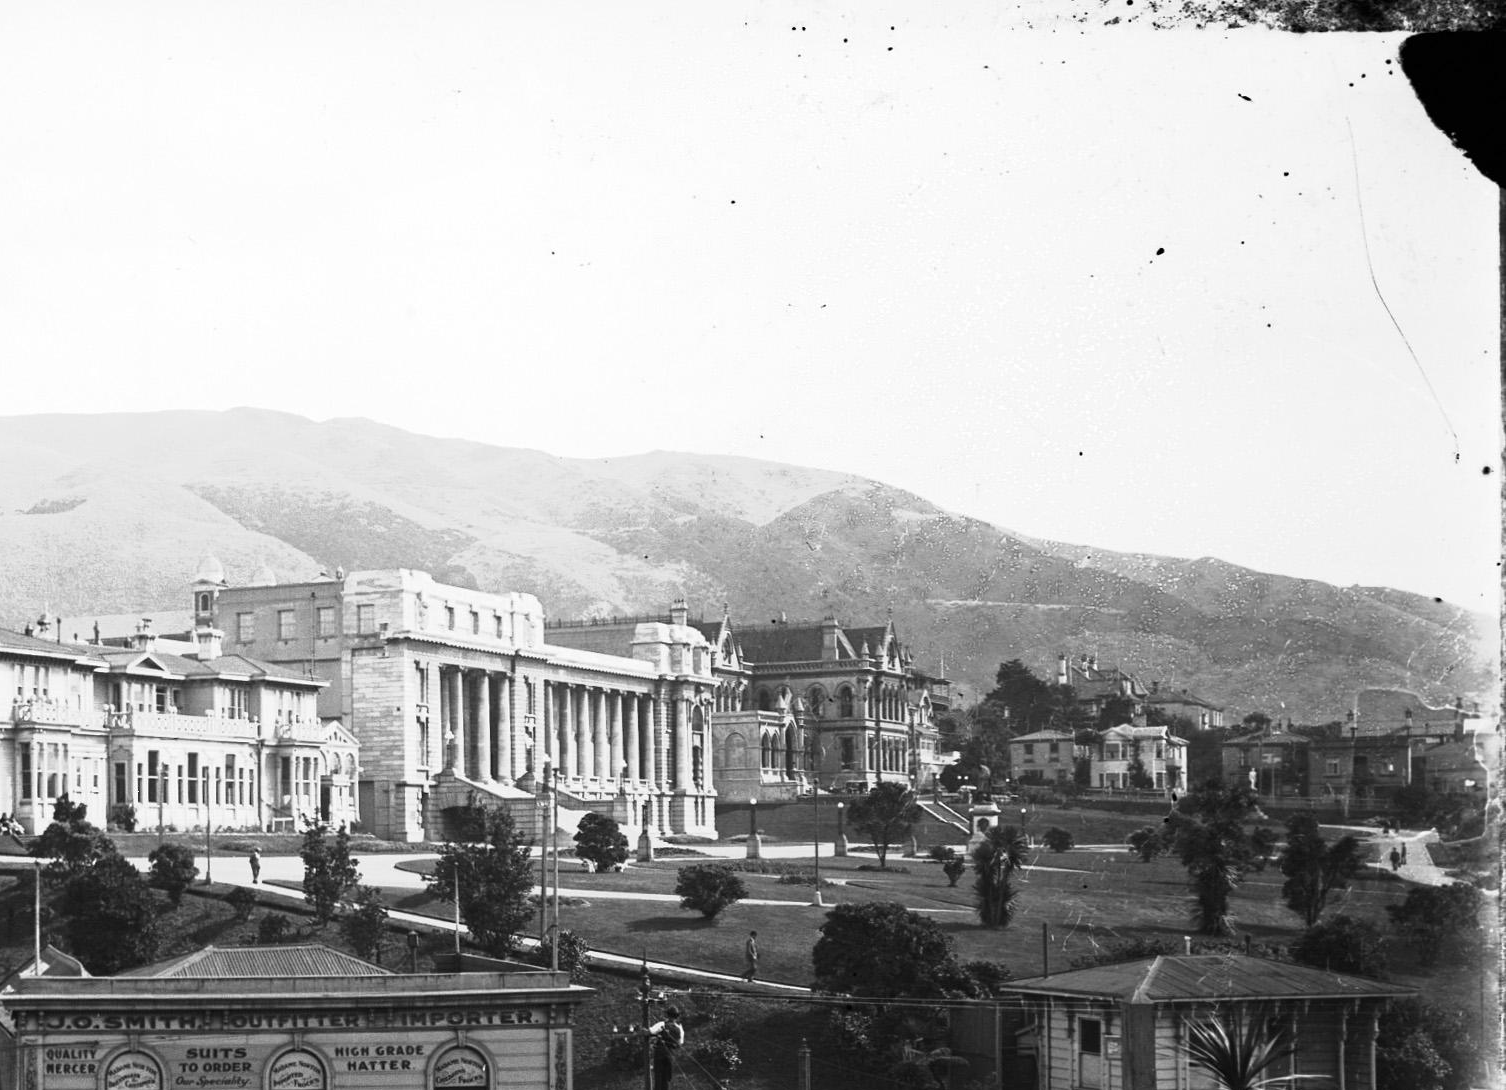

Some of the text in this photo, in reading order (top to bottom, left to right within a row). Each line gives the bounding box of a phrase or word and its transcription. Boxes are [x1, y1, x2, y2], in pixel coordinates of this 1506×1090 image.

[232, 1014, 359, 1028] OUTFITTER
[46, 1048, 97, 1060] QUALITY
[186, 1047, 247, 1059] SUITS
[335, 1045, 424, 1057] HIGH GRADE
[46, 1063, 96, 1074] MERCER
[179, 1062, 251, 1073] TO ORDER
[176, 1076, 193, 1085] Our
